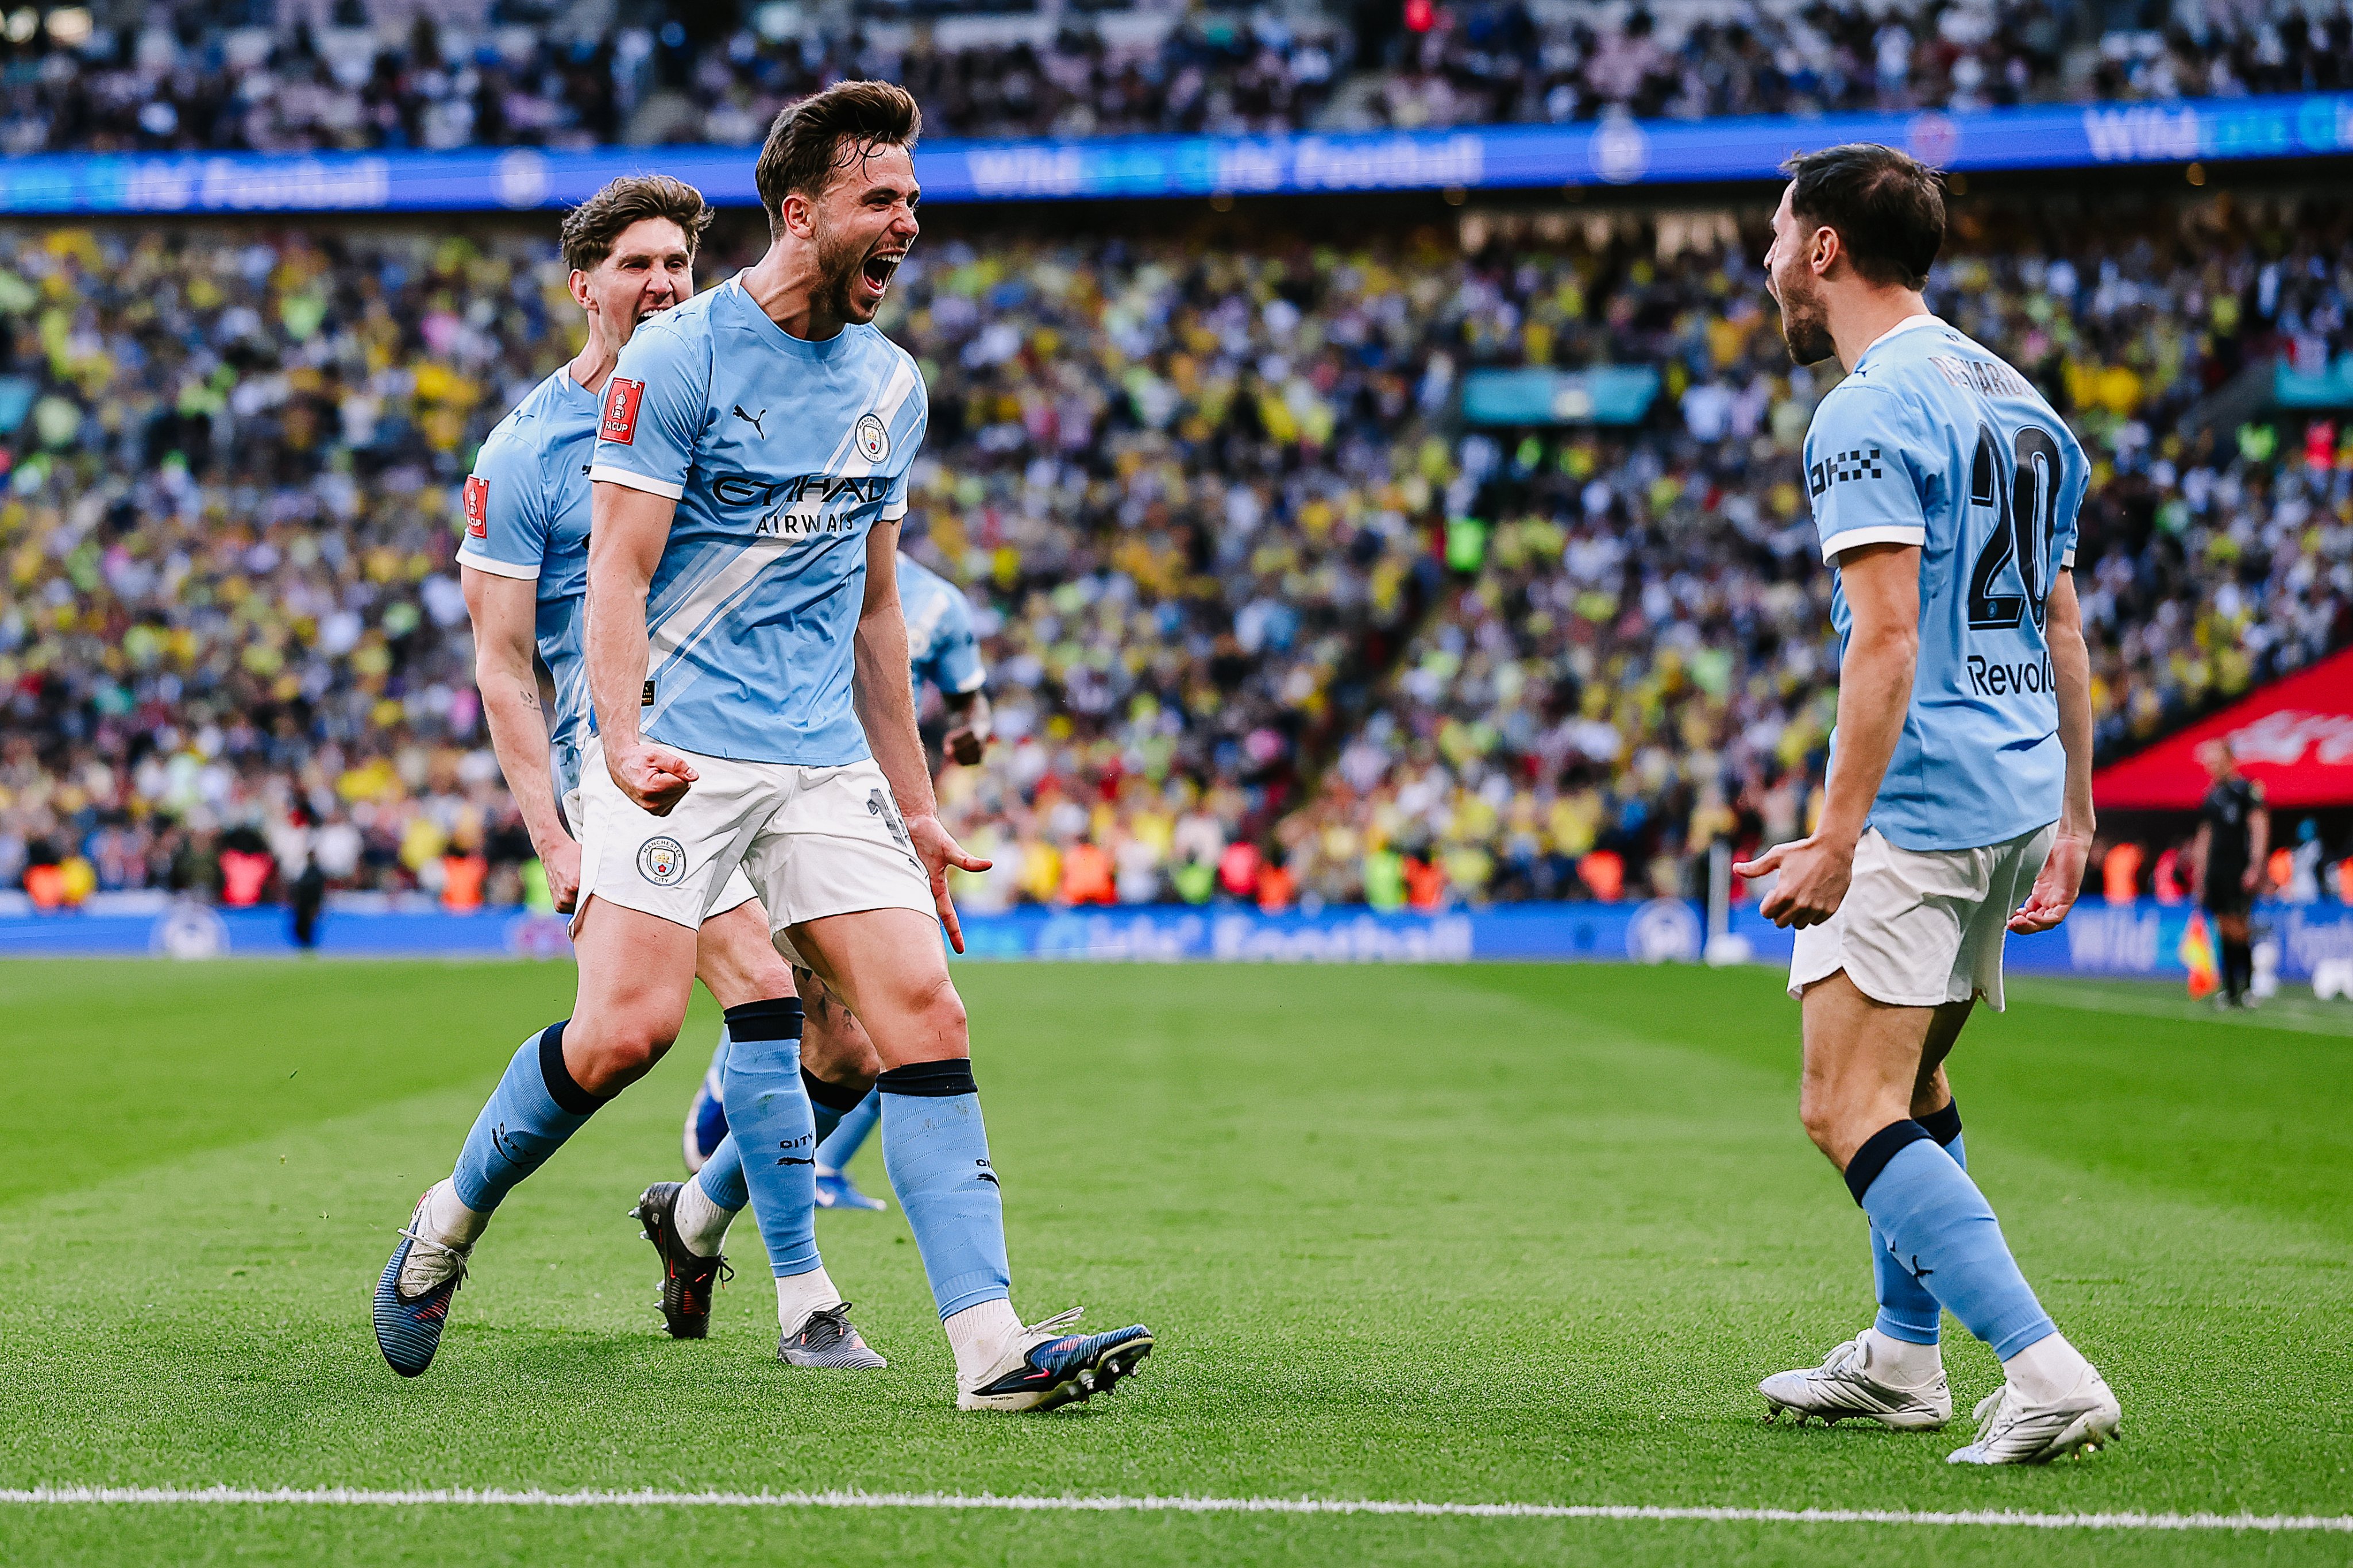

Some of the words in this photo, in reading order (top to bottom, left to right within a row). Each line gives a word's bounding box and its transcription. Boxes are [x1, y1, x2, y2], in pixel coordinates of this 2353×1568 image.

[611, 421, 628, 432] CUP
[859, 418, 884, 436] MANCHESTER
[1812, 449, 1881, 498] OKX
[712, 475, 889, 507] ETIHAD
[470, 517, 482, 527] CUP
[1968, 419, 2063, 633] 20
[866, 787, 911, 849] 1
[643, 840, 682, 858] MANCHESTER
[780, 1130, 813, 1148] CITY
[975, 1158, 990, 1168] CI
